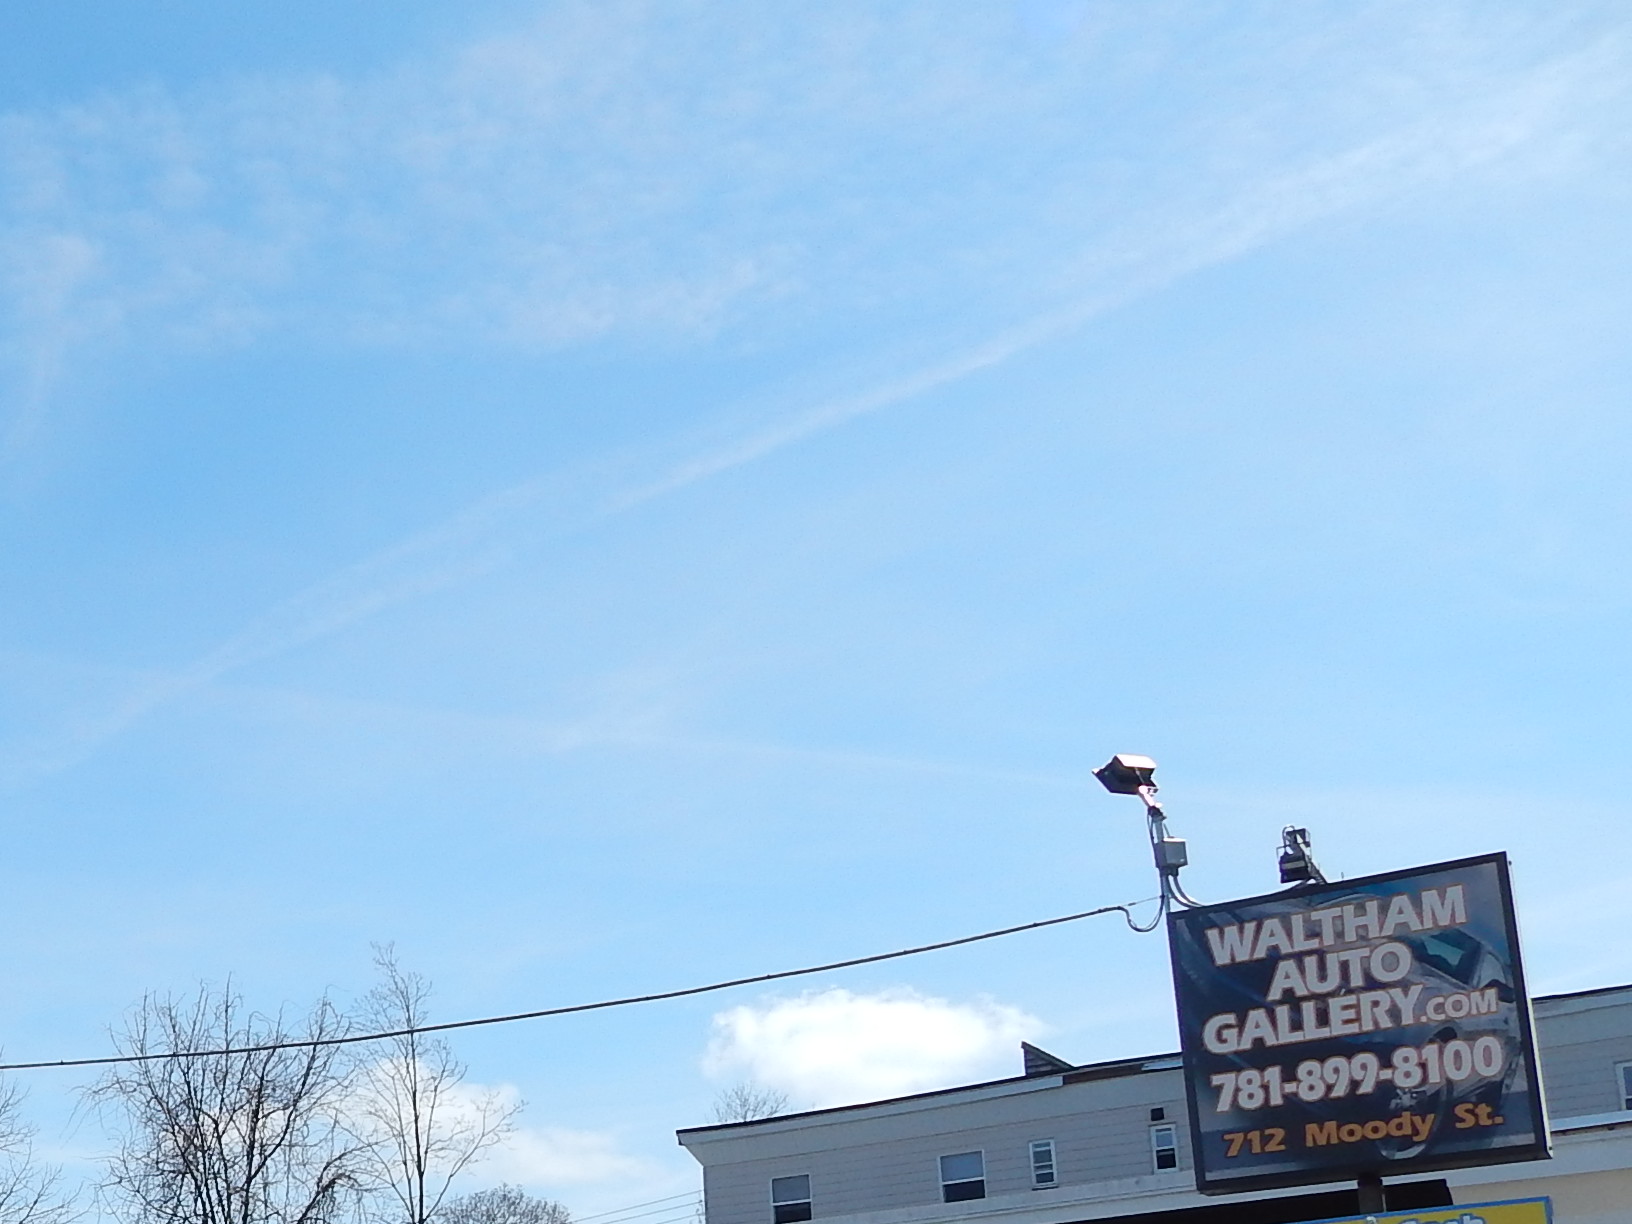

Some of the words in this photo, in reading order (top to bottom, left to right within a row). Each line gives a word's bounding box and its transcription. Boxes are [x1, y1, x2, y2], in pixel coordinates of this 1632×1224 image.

[1205, 884, 1466, 966] WALTHAM
[1267, 942, 1412, 1000] AUTO
[1211, 1035, 1502, 1112] 781-899-8100
[1223, 1127, 1286, 1157] 712
[1305, 1110, 1435, 1147] Moody
[1454, 1103, 1504, 1128] St.
